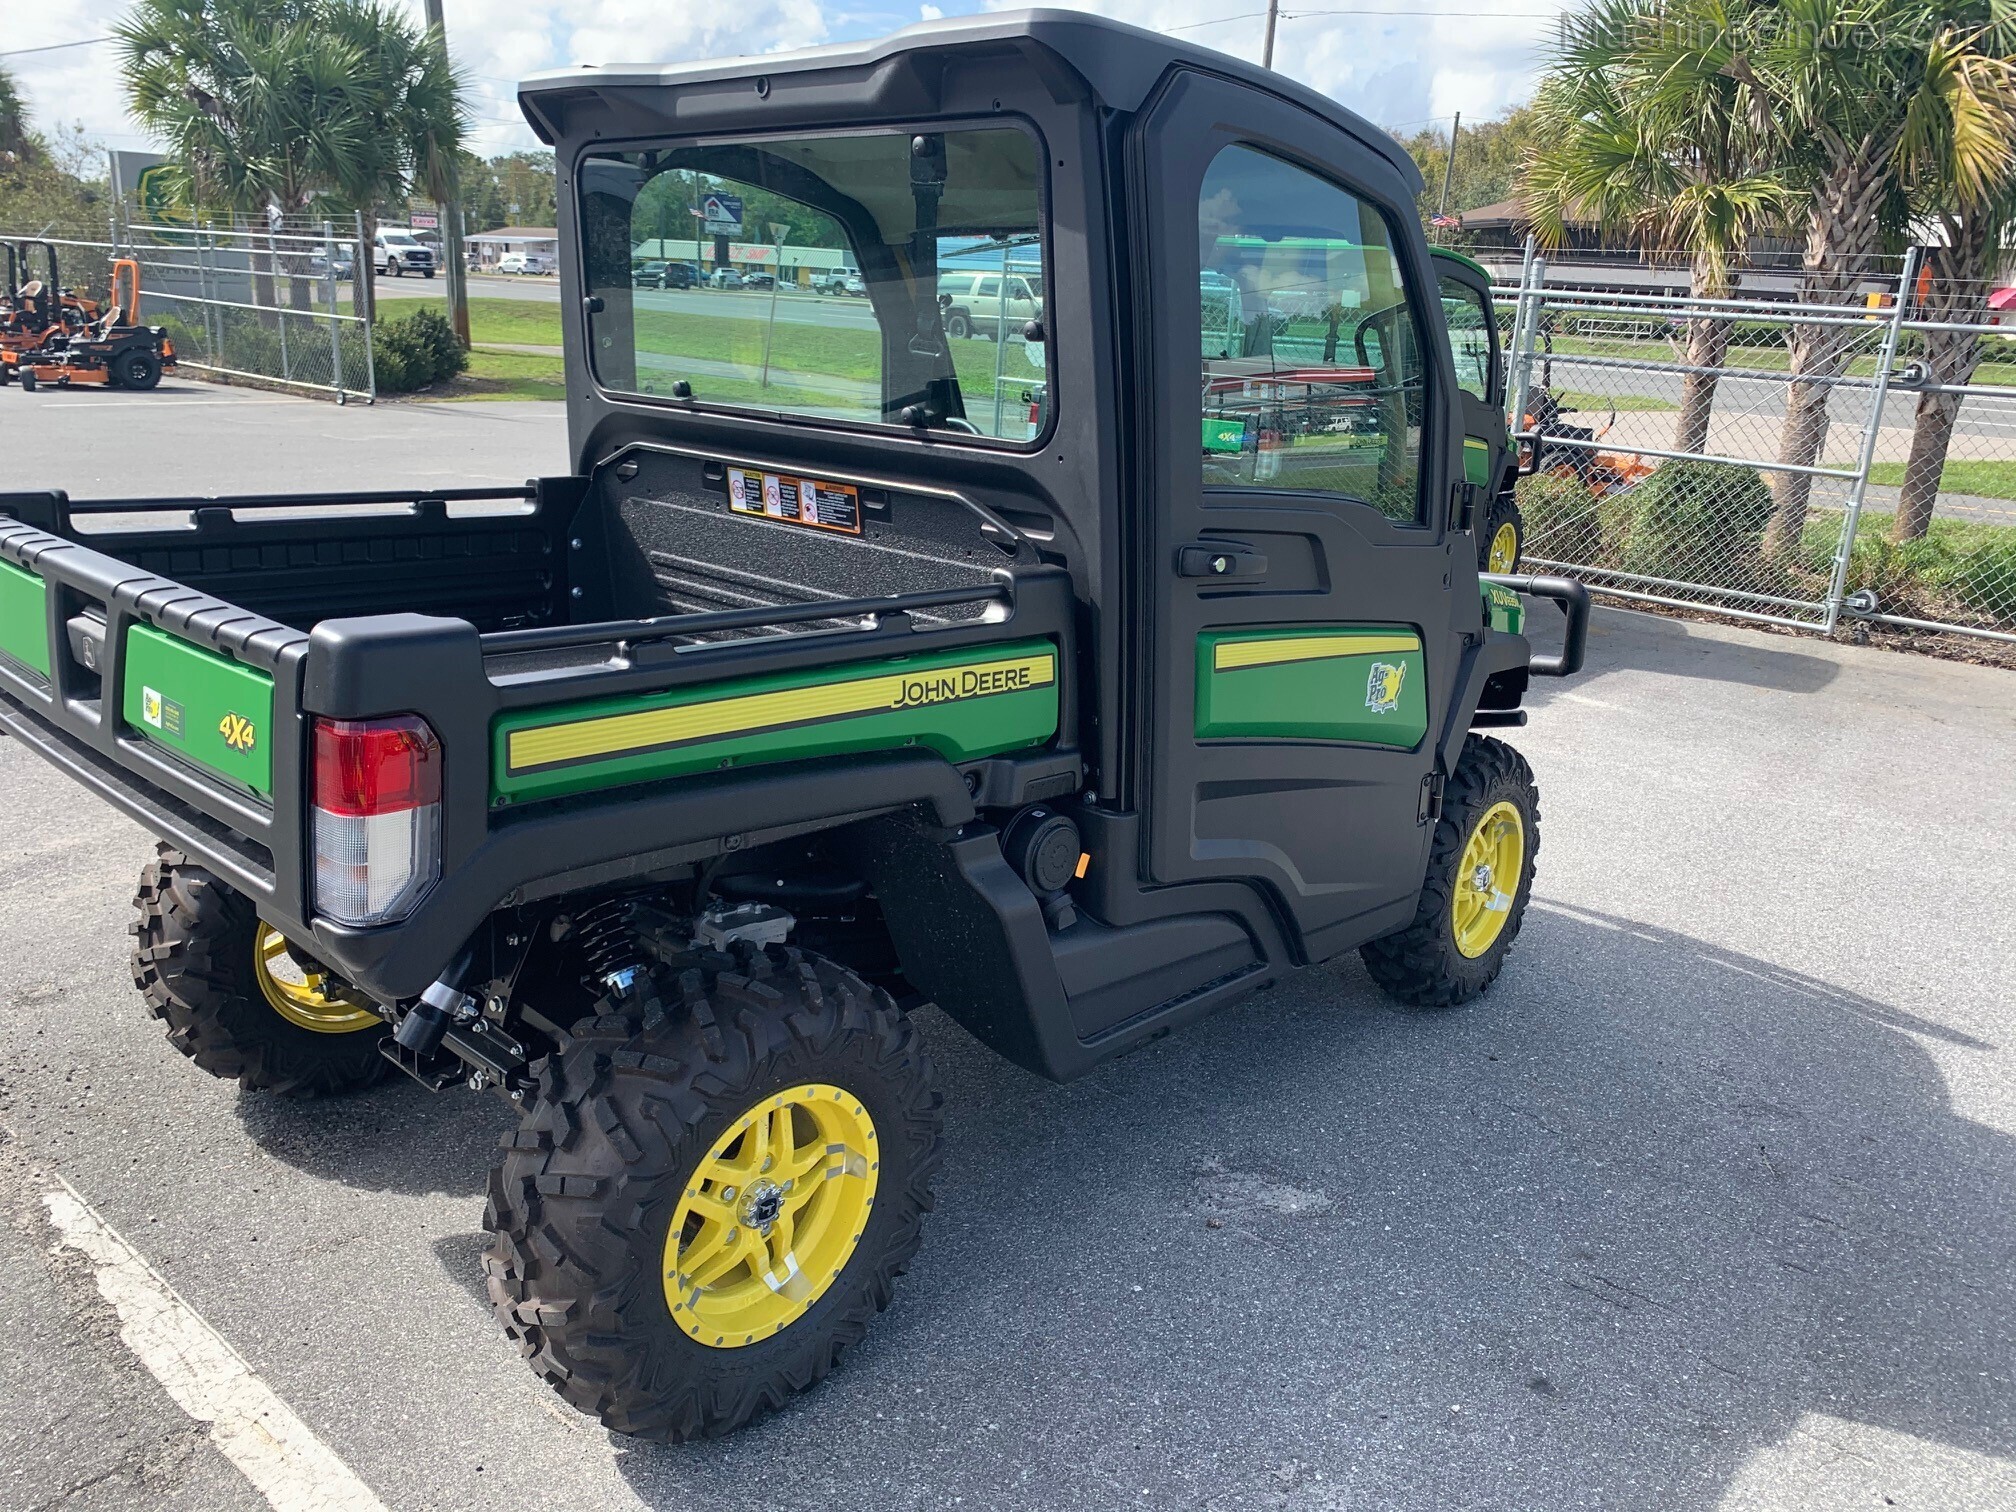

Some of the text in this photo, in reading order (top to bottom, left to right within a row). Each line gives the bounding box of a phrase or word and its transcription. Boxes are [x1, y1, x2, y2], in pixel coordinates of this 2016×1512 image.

[893, 667, 1031, 705] JOHN DEERE
[1368, 685, 1387, 702] Pro
[219, 713, 256, 750] 4X4
